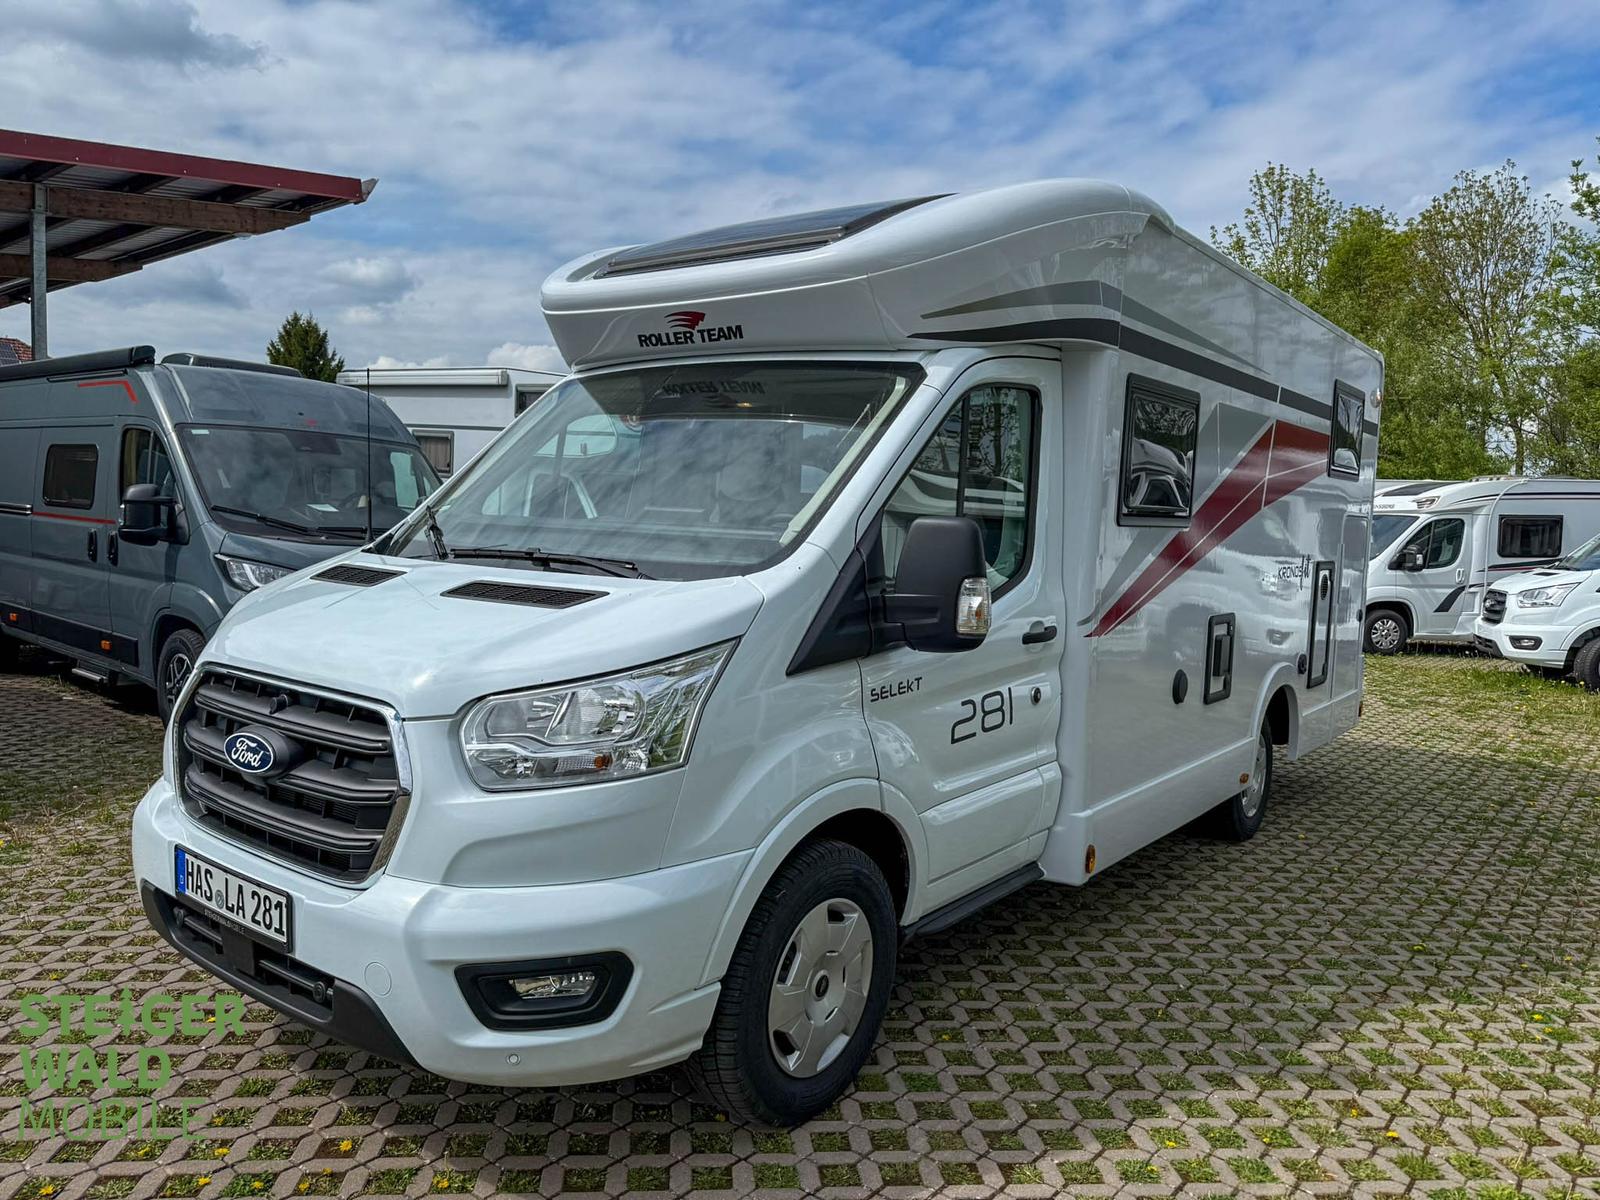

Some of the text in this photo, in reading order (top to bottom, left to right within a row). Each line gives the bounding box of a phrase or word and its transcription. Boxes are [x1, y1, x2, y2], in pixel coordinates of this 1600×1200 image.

[637, 325, 744, 348] ROLLER TEAM
[951, 687, 1013, 744] 281
[231, 737, 264, 767] Ford
[186, 858, 213, 902] HAS
[225, 877, 246, 919] LA
[251, 889, 286, 936] 281
